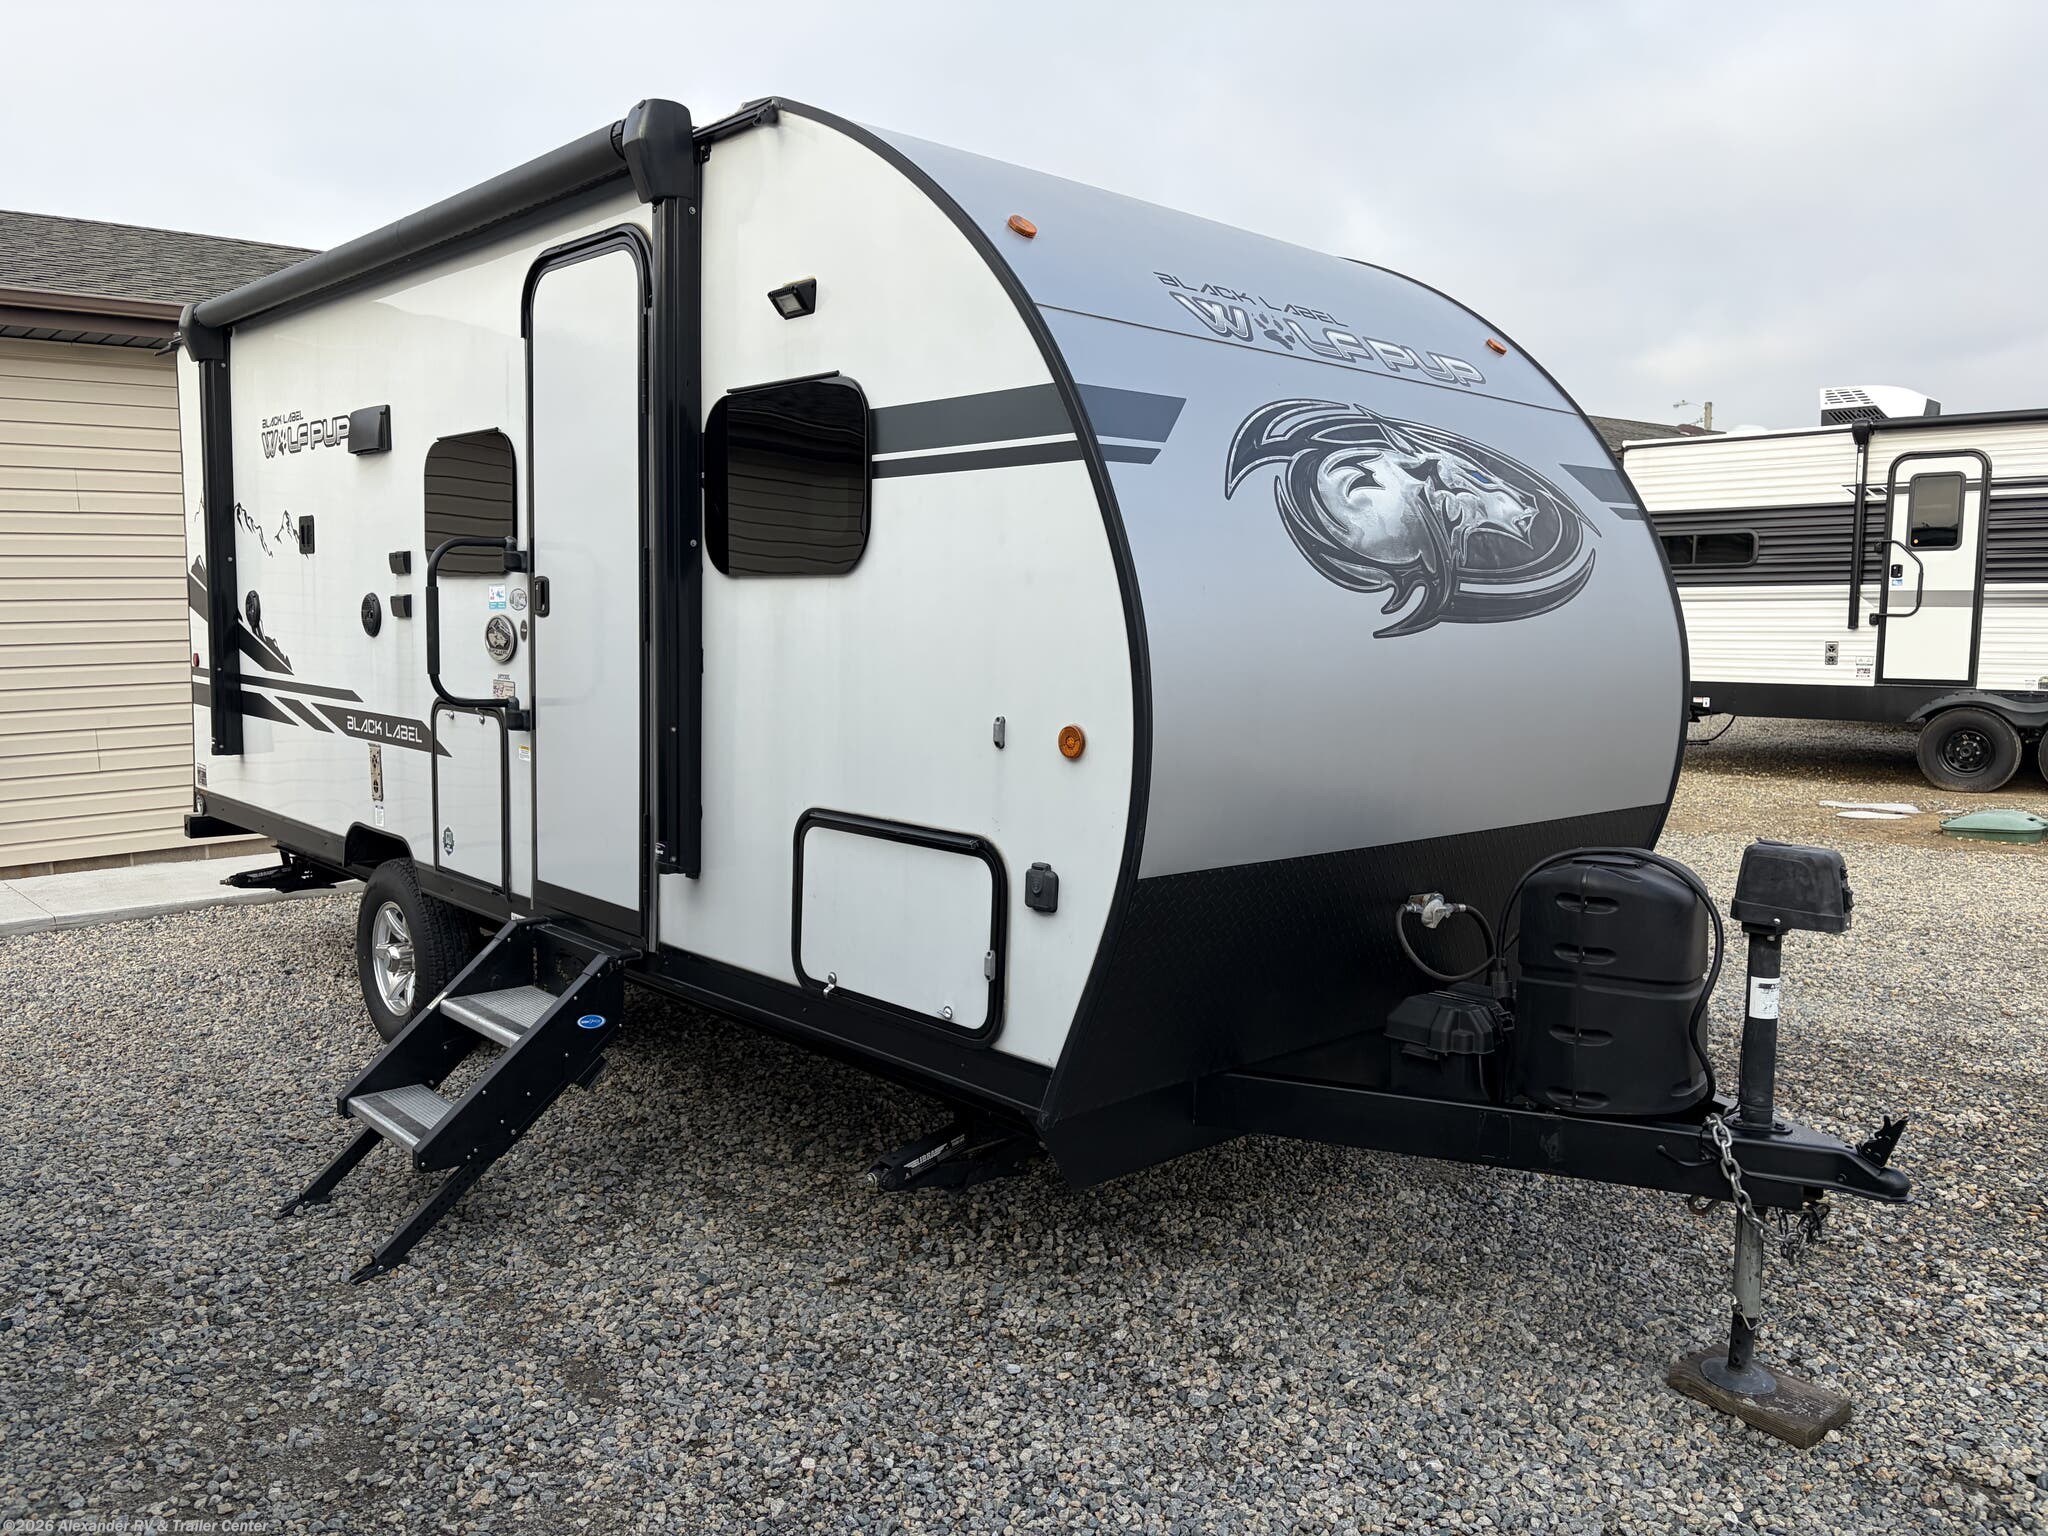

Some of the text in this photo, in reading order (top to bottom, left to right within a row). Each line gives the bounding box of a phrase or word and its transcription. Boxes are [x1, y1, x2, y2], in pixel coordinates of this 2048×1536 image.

[1152, 271, 1349, 328] BLACK LABEL
[1362, 335, 1486, 388] PUP
[261, 410, 304, 429] BLACK LABEL
[309, 414, 351, 451] PUP
[346, 715, 423, 744] BLACK LABEL
